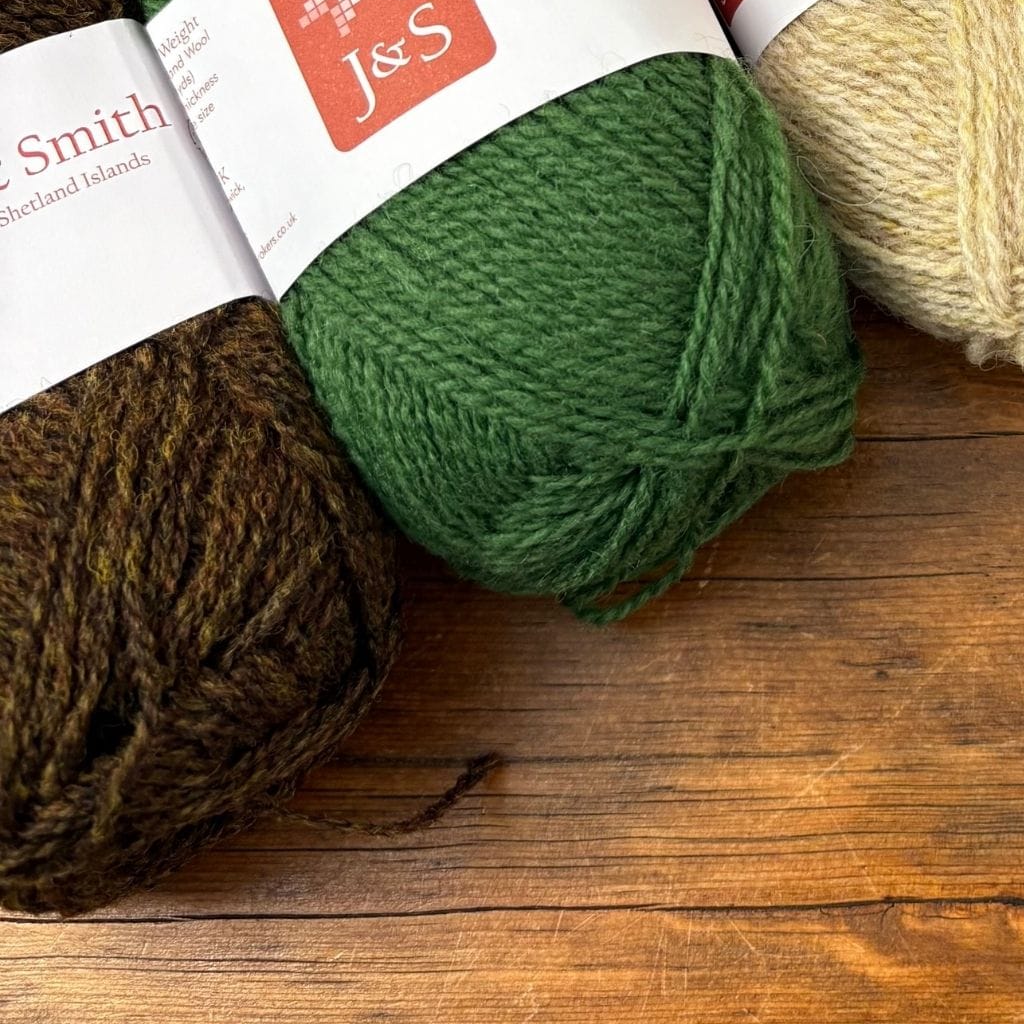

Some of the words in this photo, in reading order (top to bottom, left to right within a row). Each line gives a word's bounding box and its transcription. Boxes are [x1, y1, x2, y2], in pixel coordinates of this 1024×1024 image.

[158, 16, 200, 57] Weight
[184, 29, 211, 59] Wool
[341, 1, 453, 123] J&S
[17, 93, 172, 176] Smith
[197, 102, 216, 123] size
[0, 176, 81, 227] Shetland
[80, 152, 151, 189] Islands
